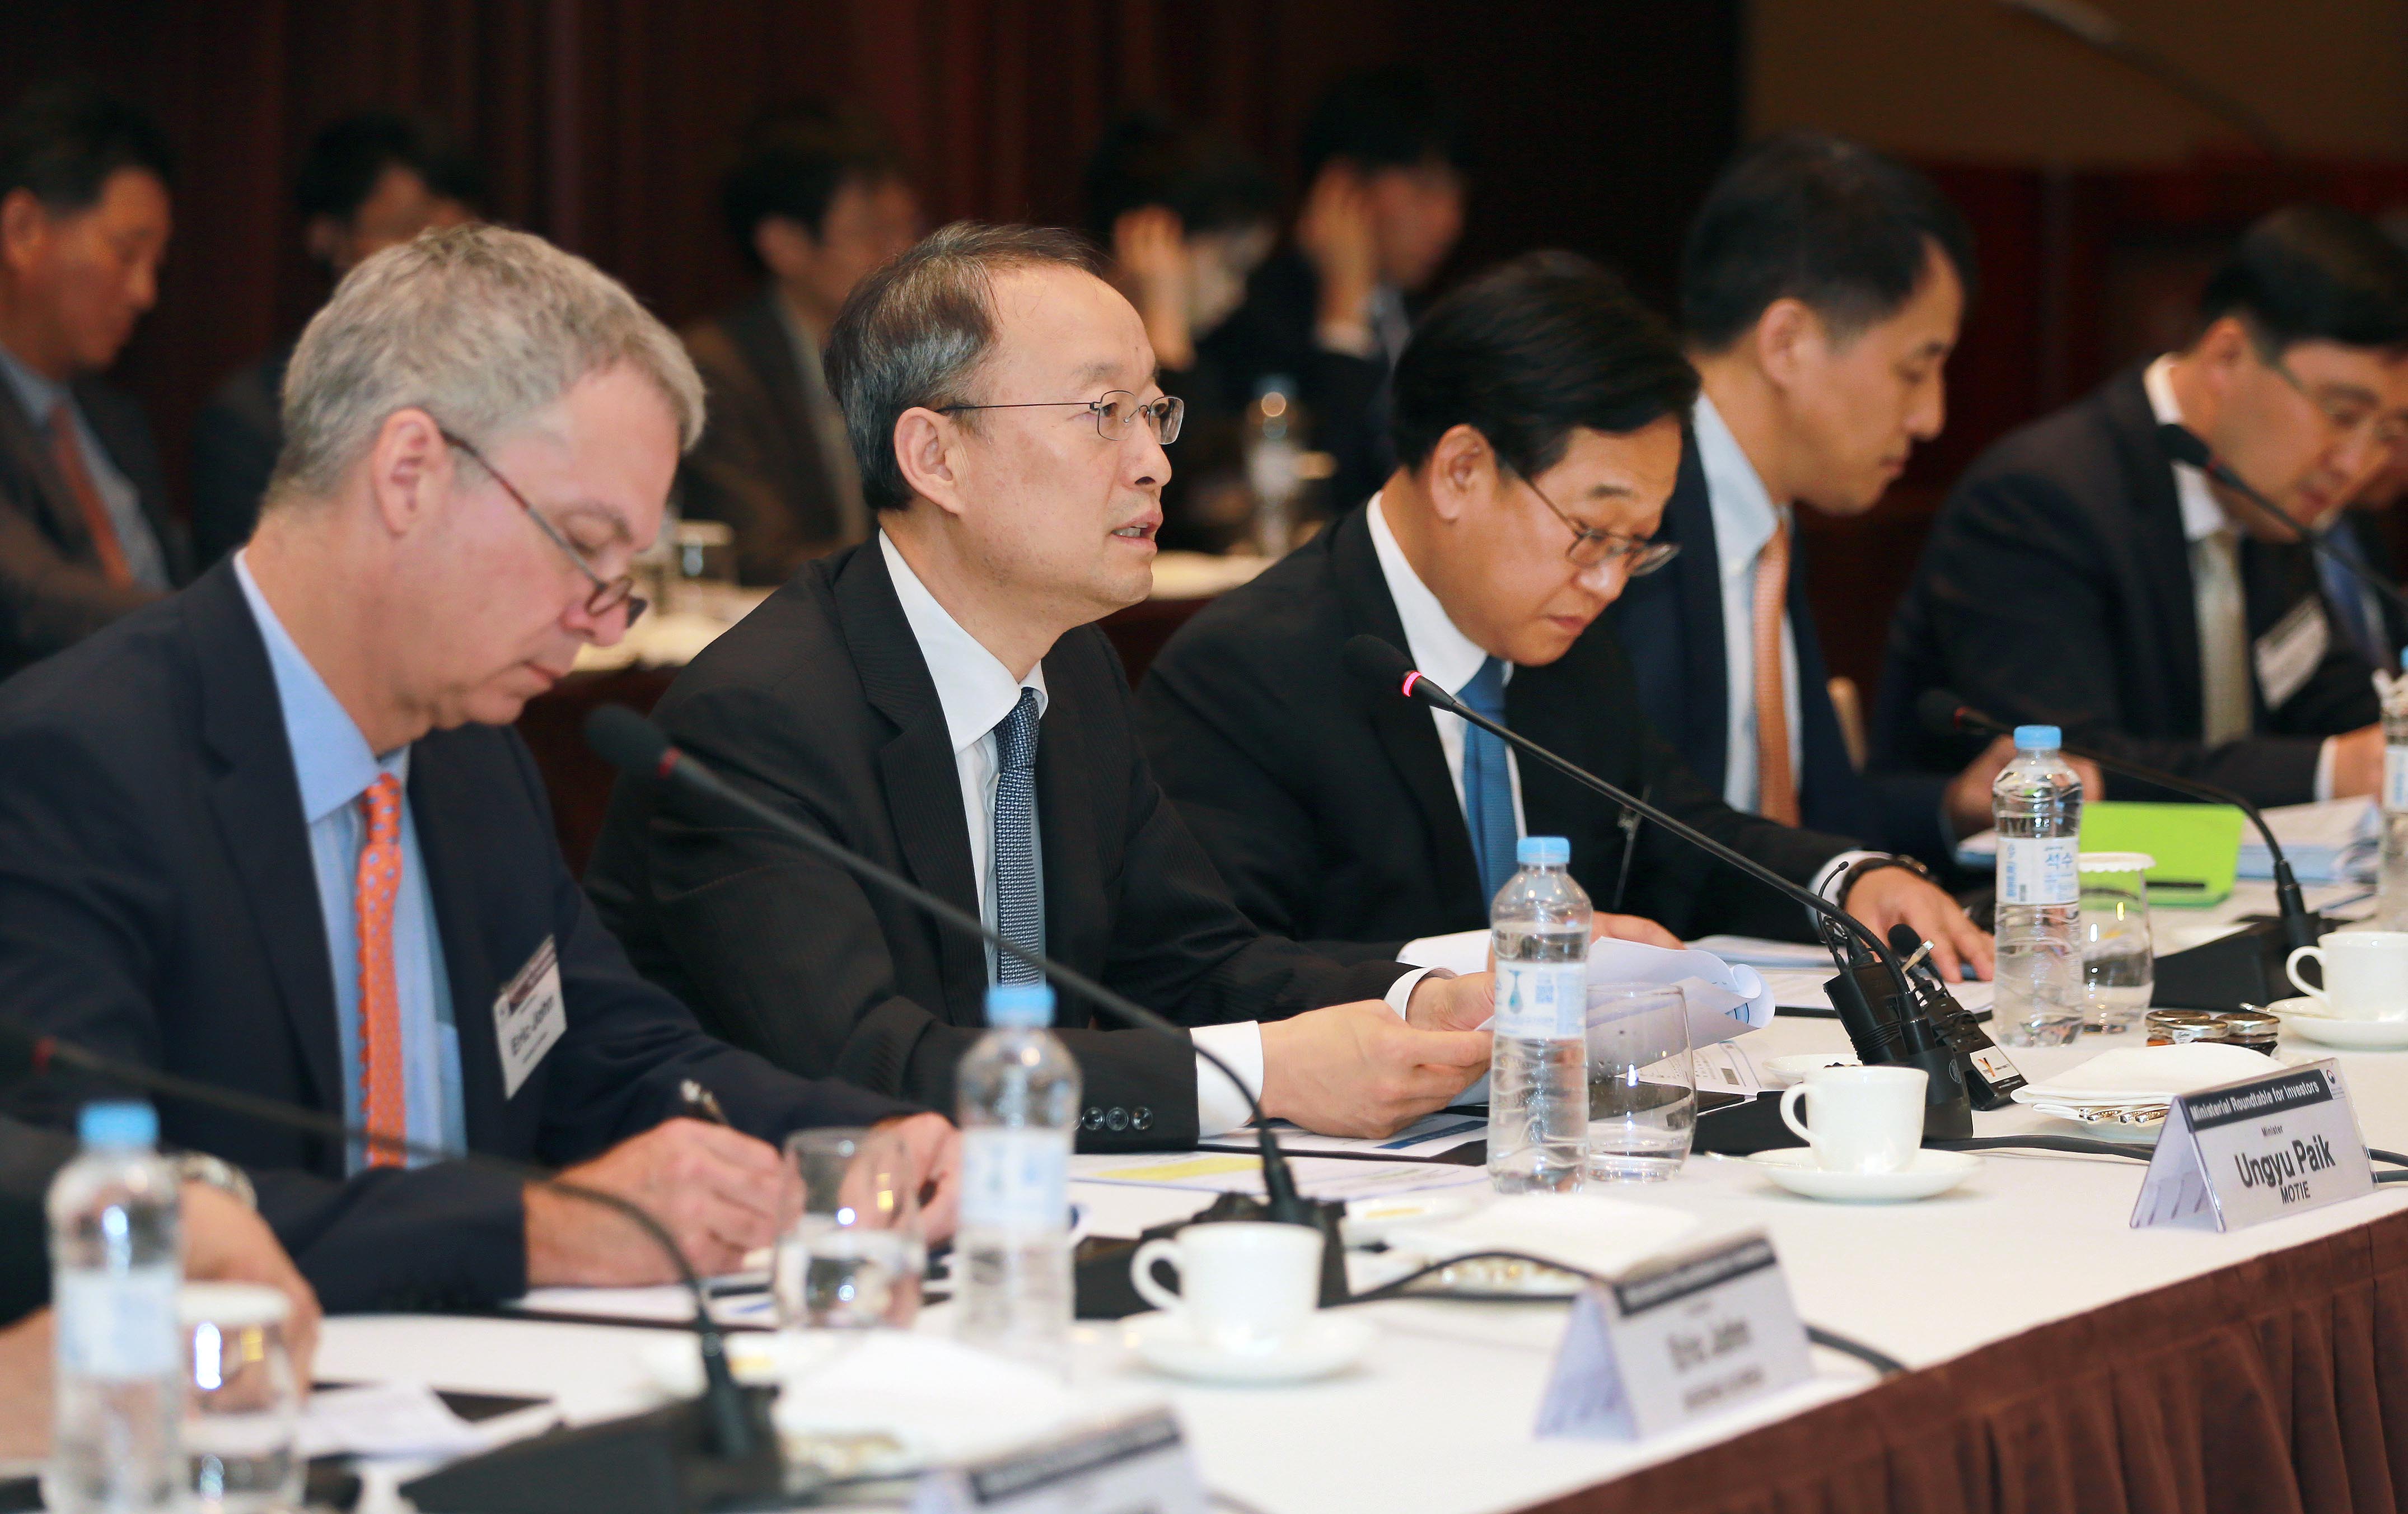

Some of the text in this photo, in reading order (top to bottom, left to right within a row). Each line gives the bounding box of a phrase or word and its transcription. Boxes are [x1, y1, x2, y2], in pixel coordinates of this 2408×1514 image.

[2190, 1098, 2232, 1120] Ministerial
[2230, 1090, 2273, 1111] Roundtable
[2272, 1087, 2285, 1102] for
[2283, 1081, 2320, 1099] Investors
[2261, 1125, 2284, 1137] Minister
[2234, 1133, 2336, 1188] Ungyu Paik
[2280, 1180, 2311, 1204] MOTIE
